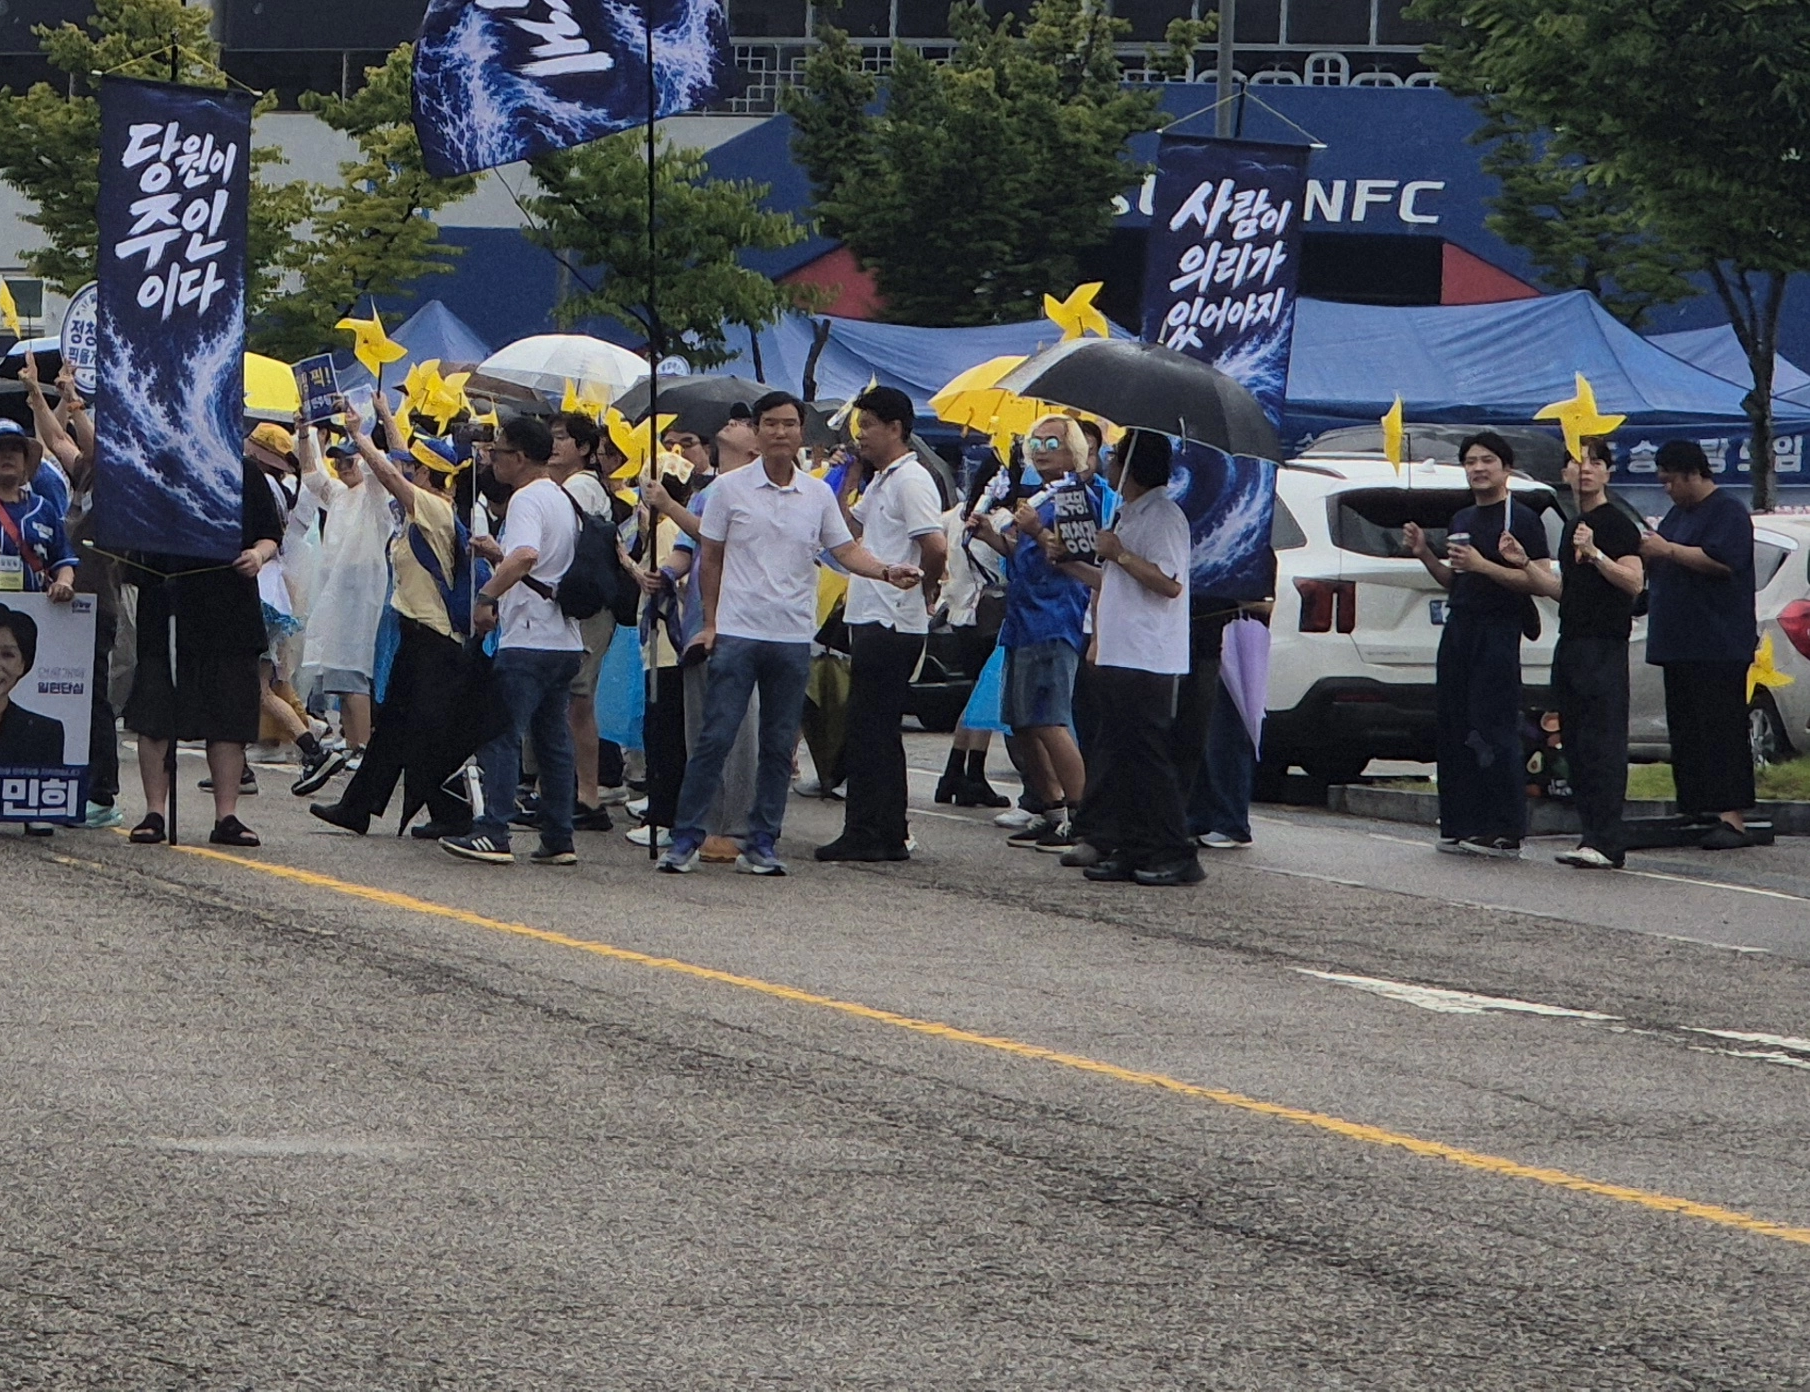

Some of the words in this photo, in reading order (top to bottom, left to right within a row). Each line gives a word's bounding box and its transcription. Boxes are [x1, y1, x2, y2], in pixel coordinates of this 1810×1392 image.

[121, 121, 237, 193] 당원이
[115, 188, 230, 271] 주인
[1169, 178, 1292, 240] 사람이
[136, 261, 226, 323] 이다
[1168, 239, 1288, 293] 의리가
[1166, 287, 1286, 352] 있어야지
